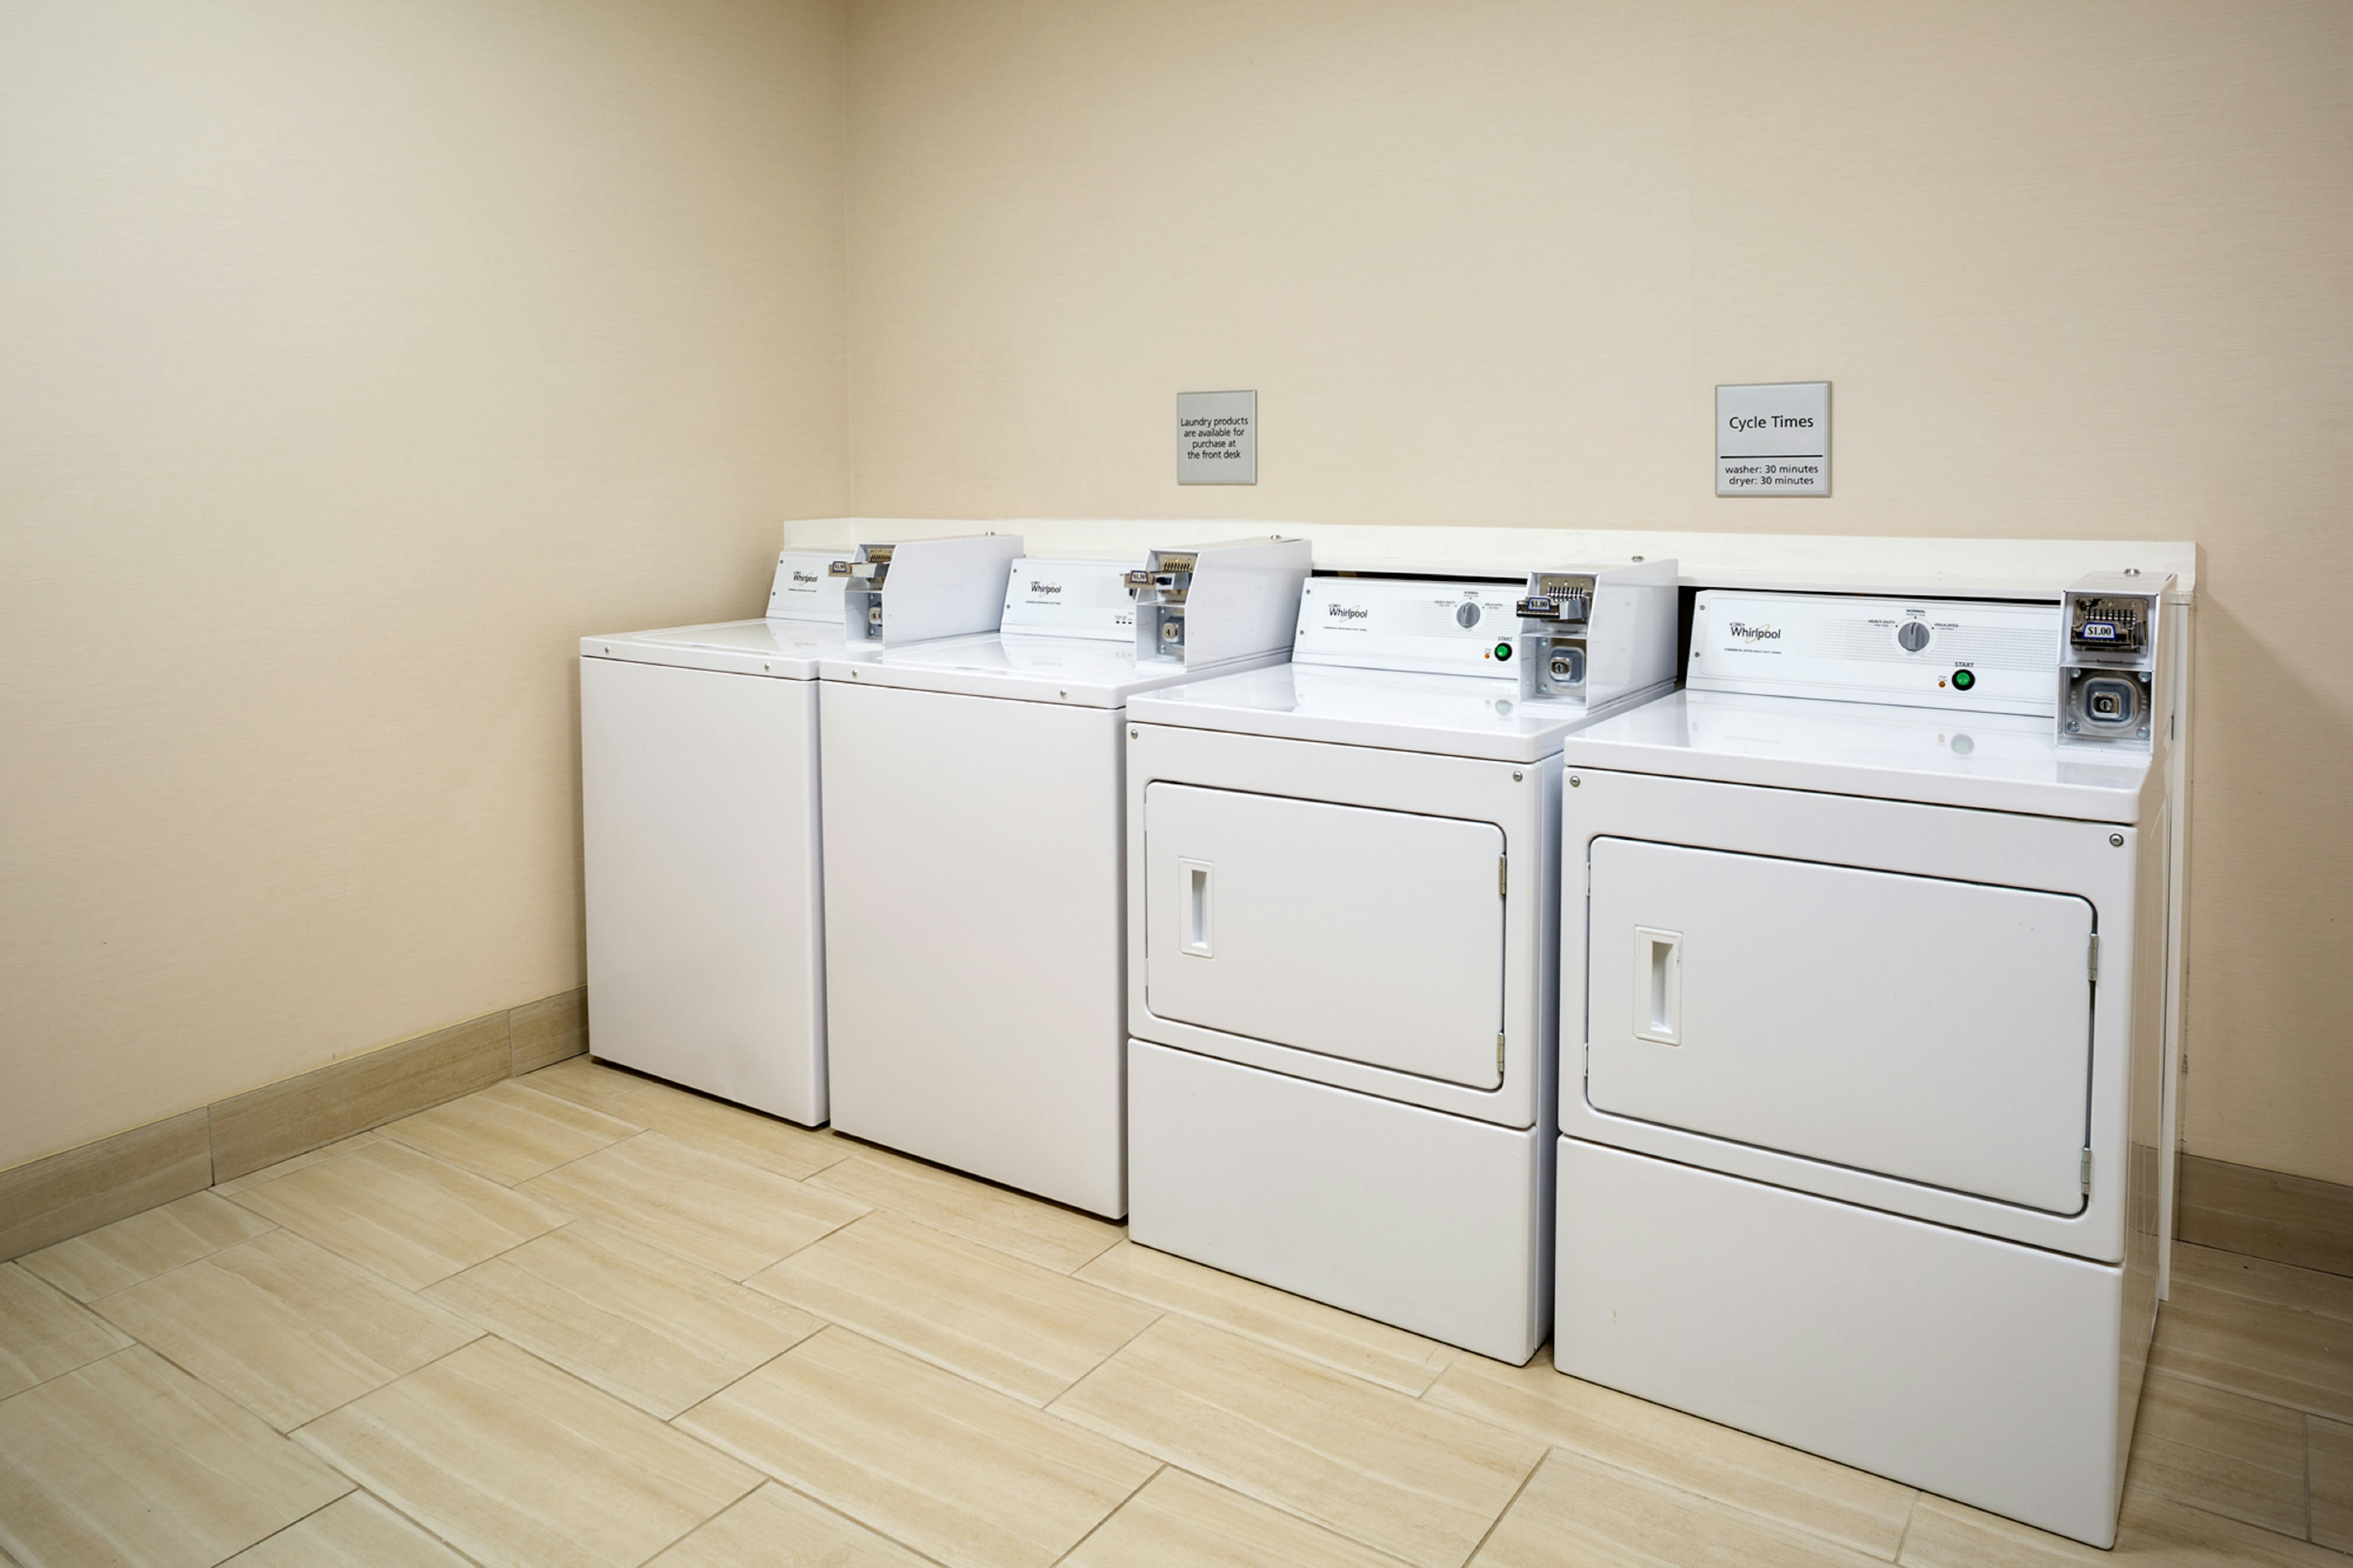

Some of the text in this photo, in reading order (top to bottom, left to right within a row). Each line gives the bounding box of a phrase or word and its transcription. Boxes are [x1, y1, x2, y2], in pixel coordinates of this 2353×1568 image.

[1181, 416, 1248, 428] Laundry products
[1729, 415, 1814, 432] Cycle Times
[1198, 428, 1231, 437] available
[1233, 427, 1245, 437] for
[1192, 439, 1226, 450] purchase
[1188, 450, 1241, 459] the front desk
[1724, 464, 1818, 474] washer: 30 minutes
[1729, 476, 1814, 487] dryer: 30 minutes
[794, 574, 818, 584] Whirlpool
[1031, 584, 1062, 595] Whirlpool
[1530, 600, 1547, 608] $1.00
[1329, 607, 1367, 619] Whirlpool
[1730, 626, 1781, 640] Whirlpool
[2087, 626, 2111, 636] $1.00
